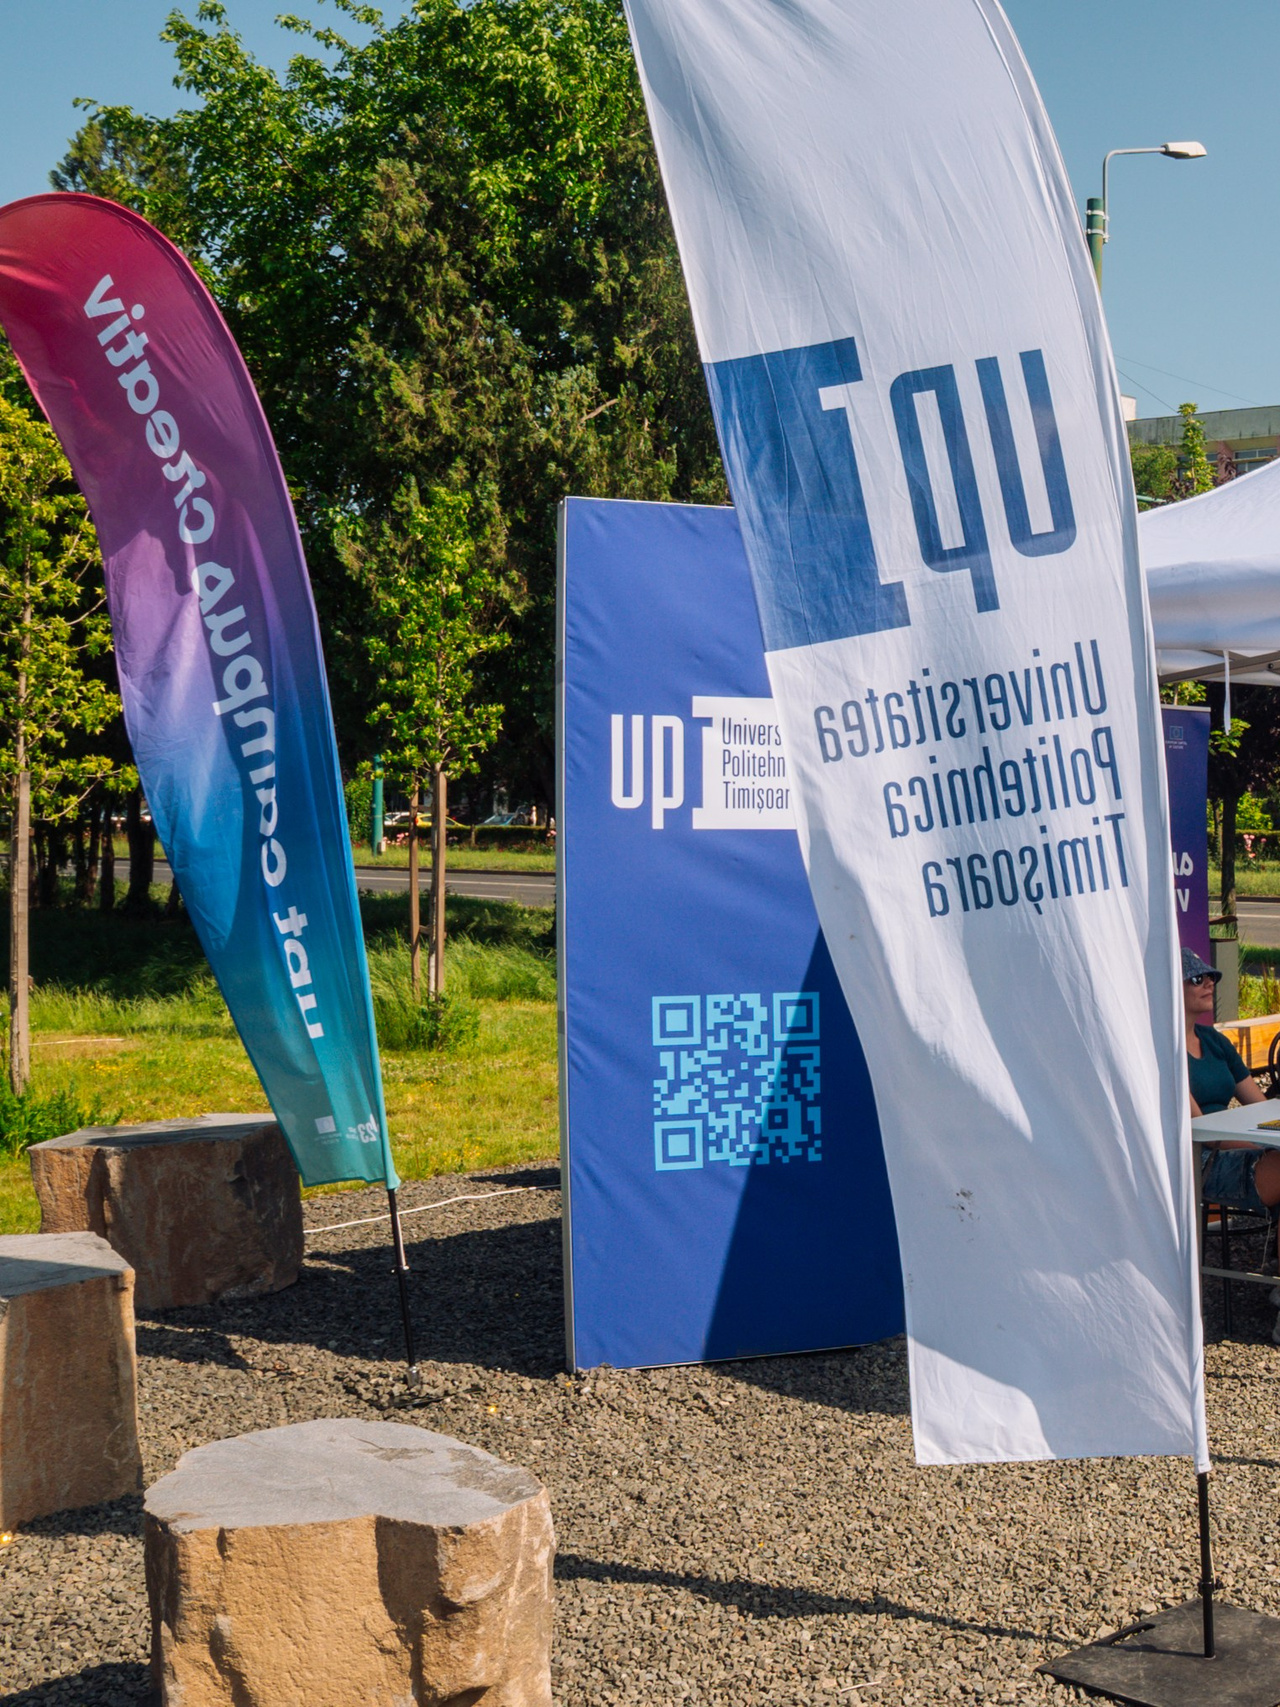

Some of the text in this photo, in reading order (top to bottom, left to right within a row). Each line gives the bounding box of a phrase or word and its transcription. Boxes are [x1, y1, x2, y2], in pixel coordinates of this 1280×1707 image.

[722, 717, 782, 747] Univers
[722, 749, 786, 778] Politehn
[723, 781, 790, 814] Timișoar
